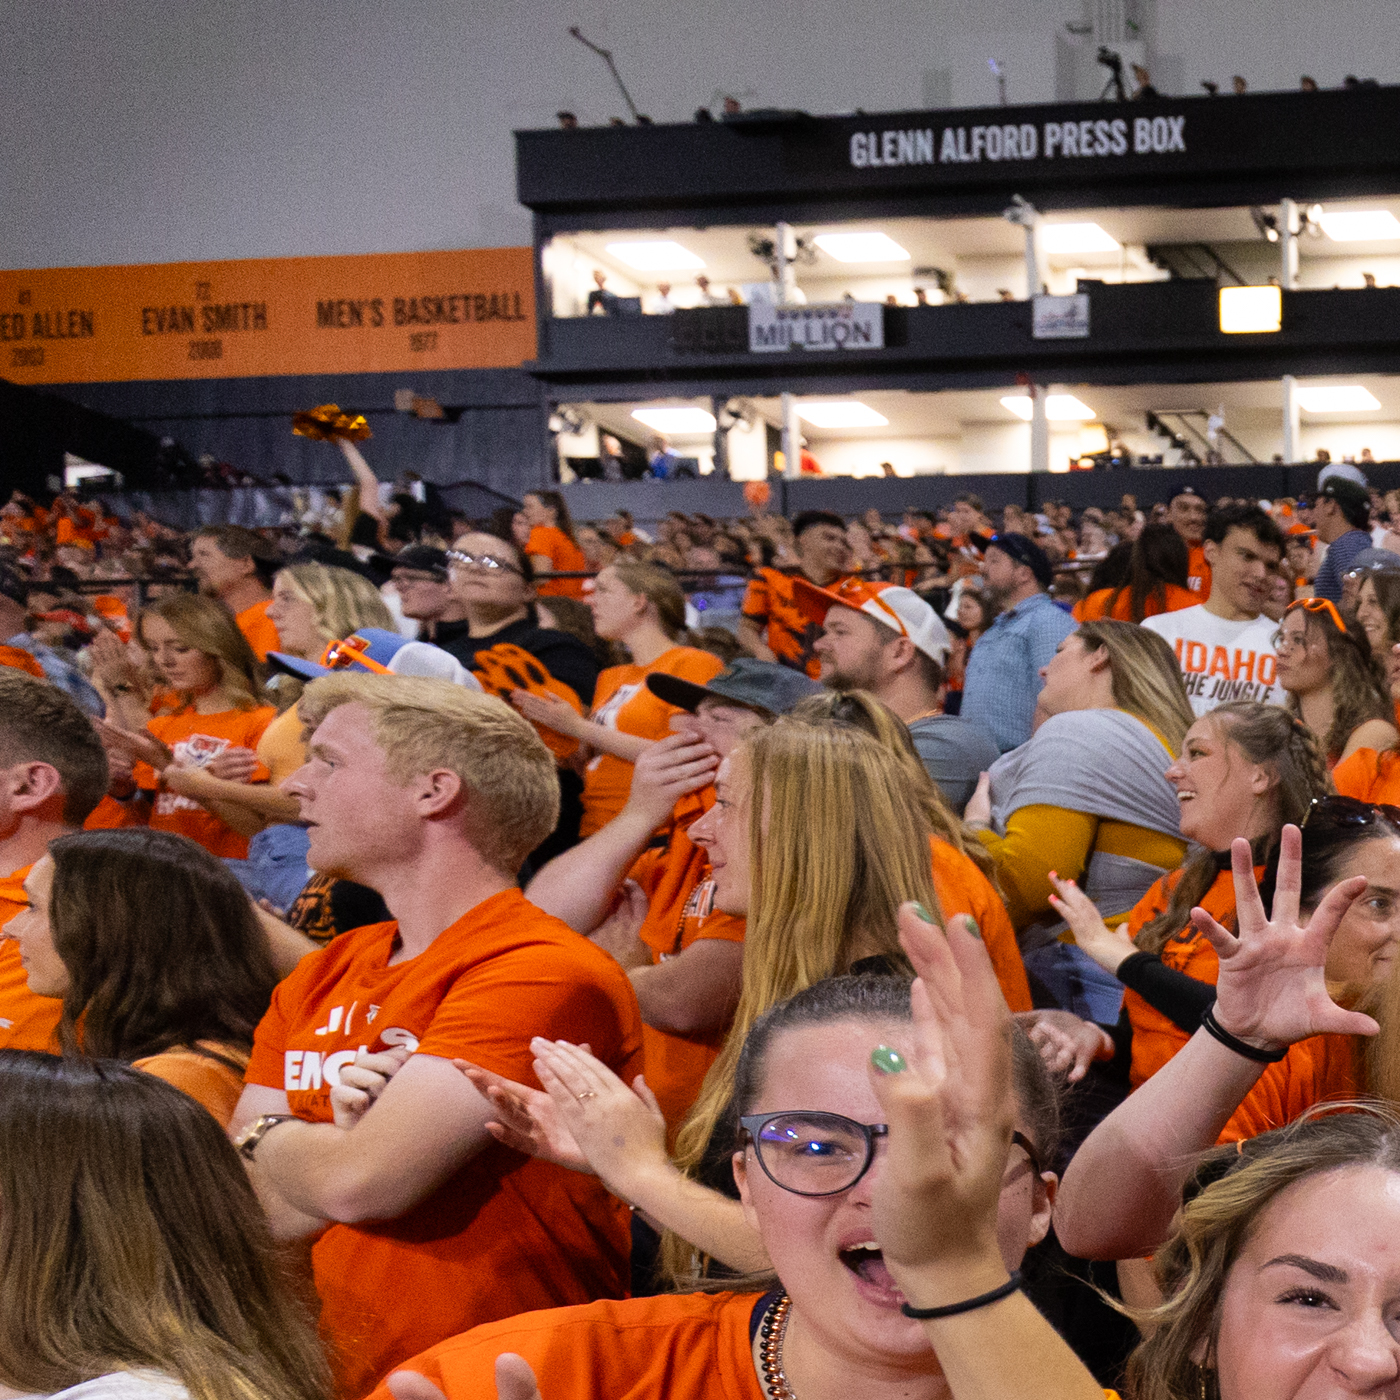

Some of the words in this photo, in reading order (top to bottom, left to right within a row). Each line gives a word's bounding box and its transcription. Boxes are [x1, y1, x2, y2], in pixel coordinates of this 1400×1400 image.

[851, 131, 934, 168] GLENN
[941, 124, 1037, 163] ALFORD
[1044, 119, 1128, 157] PRESS
[1134, 115, 1186, 153] BOX
[33, 309, 94, 339] ALLEN
[142, 306, 195, 335] EVAN
[202, 302, 267, 332] SMITH
[317, 298, 384, 329] MEN'S
[393, 292, 526, 327] BASKETBALL
